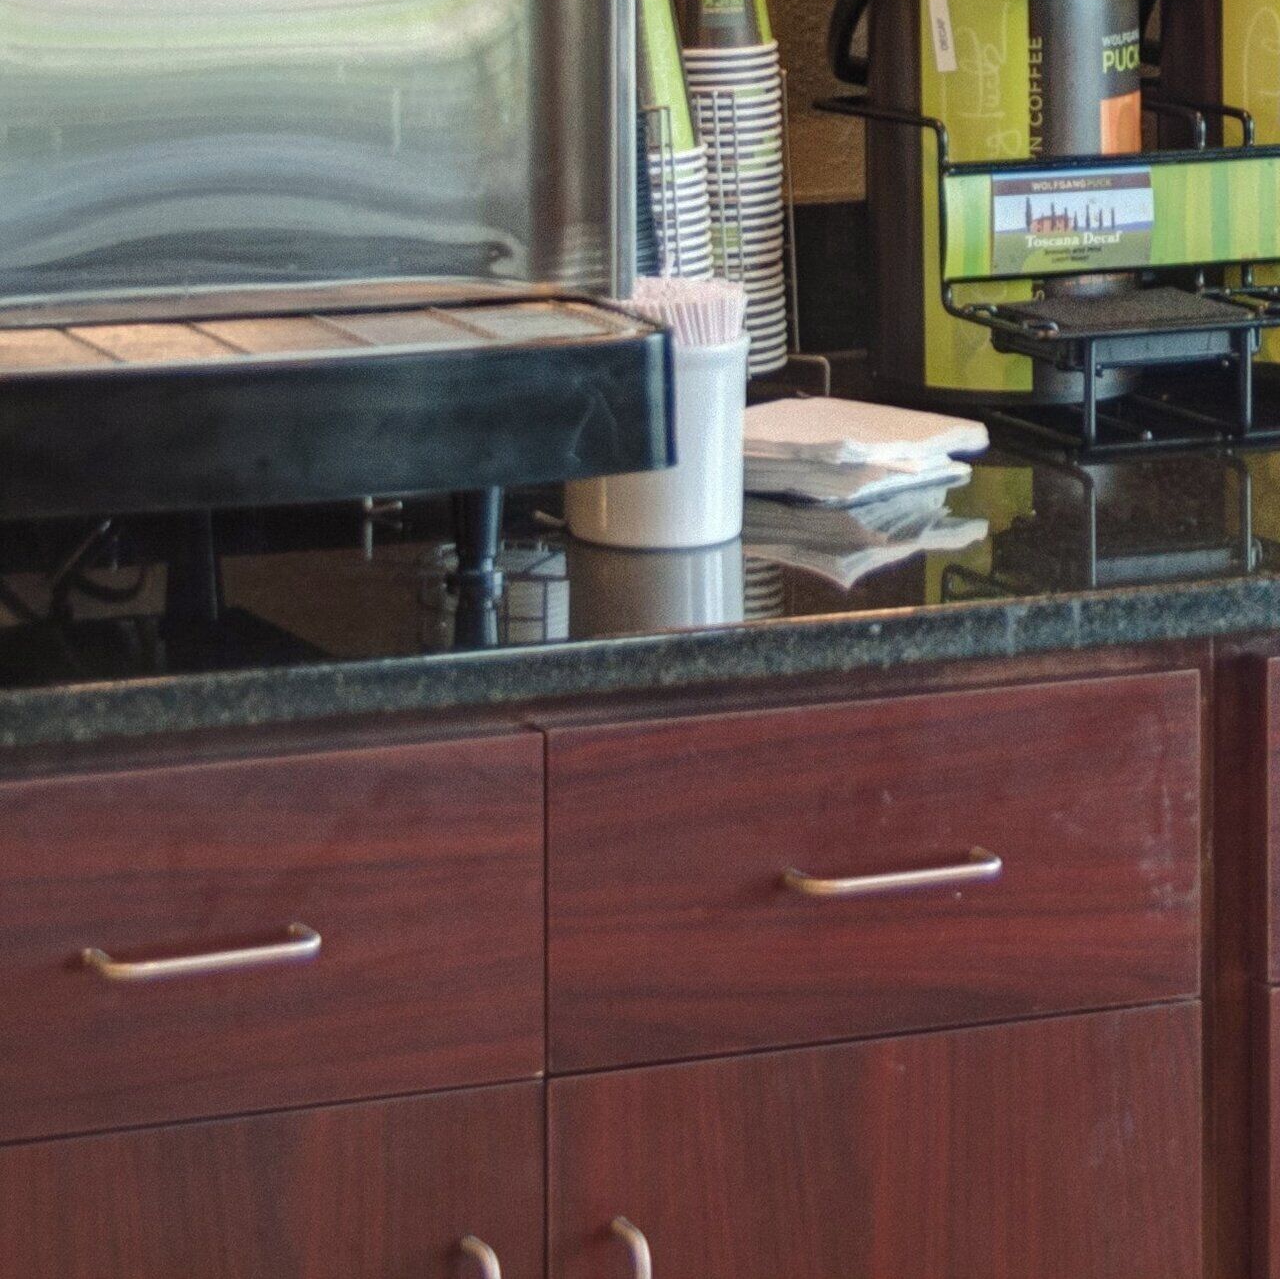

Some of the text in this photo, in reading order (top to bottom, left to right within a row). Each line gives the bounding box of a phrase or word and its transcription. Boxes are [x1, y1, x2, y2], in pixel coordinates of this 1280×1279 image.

[937, 18, 949, 52] DECAF
[1102, 43, 1140, 74] PUC
[1030, 36, 1043, 127] COFFEE
[1025, 230, 1123, 249] Toscana Decaf
